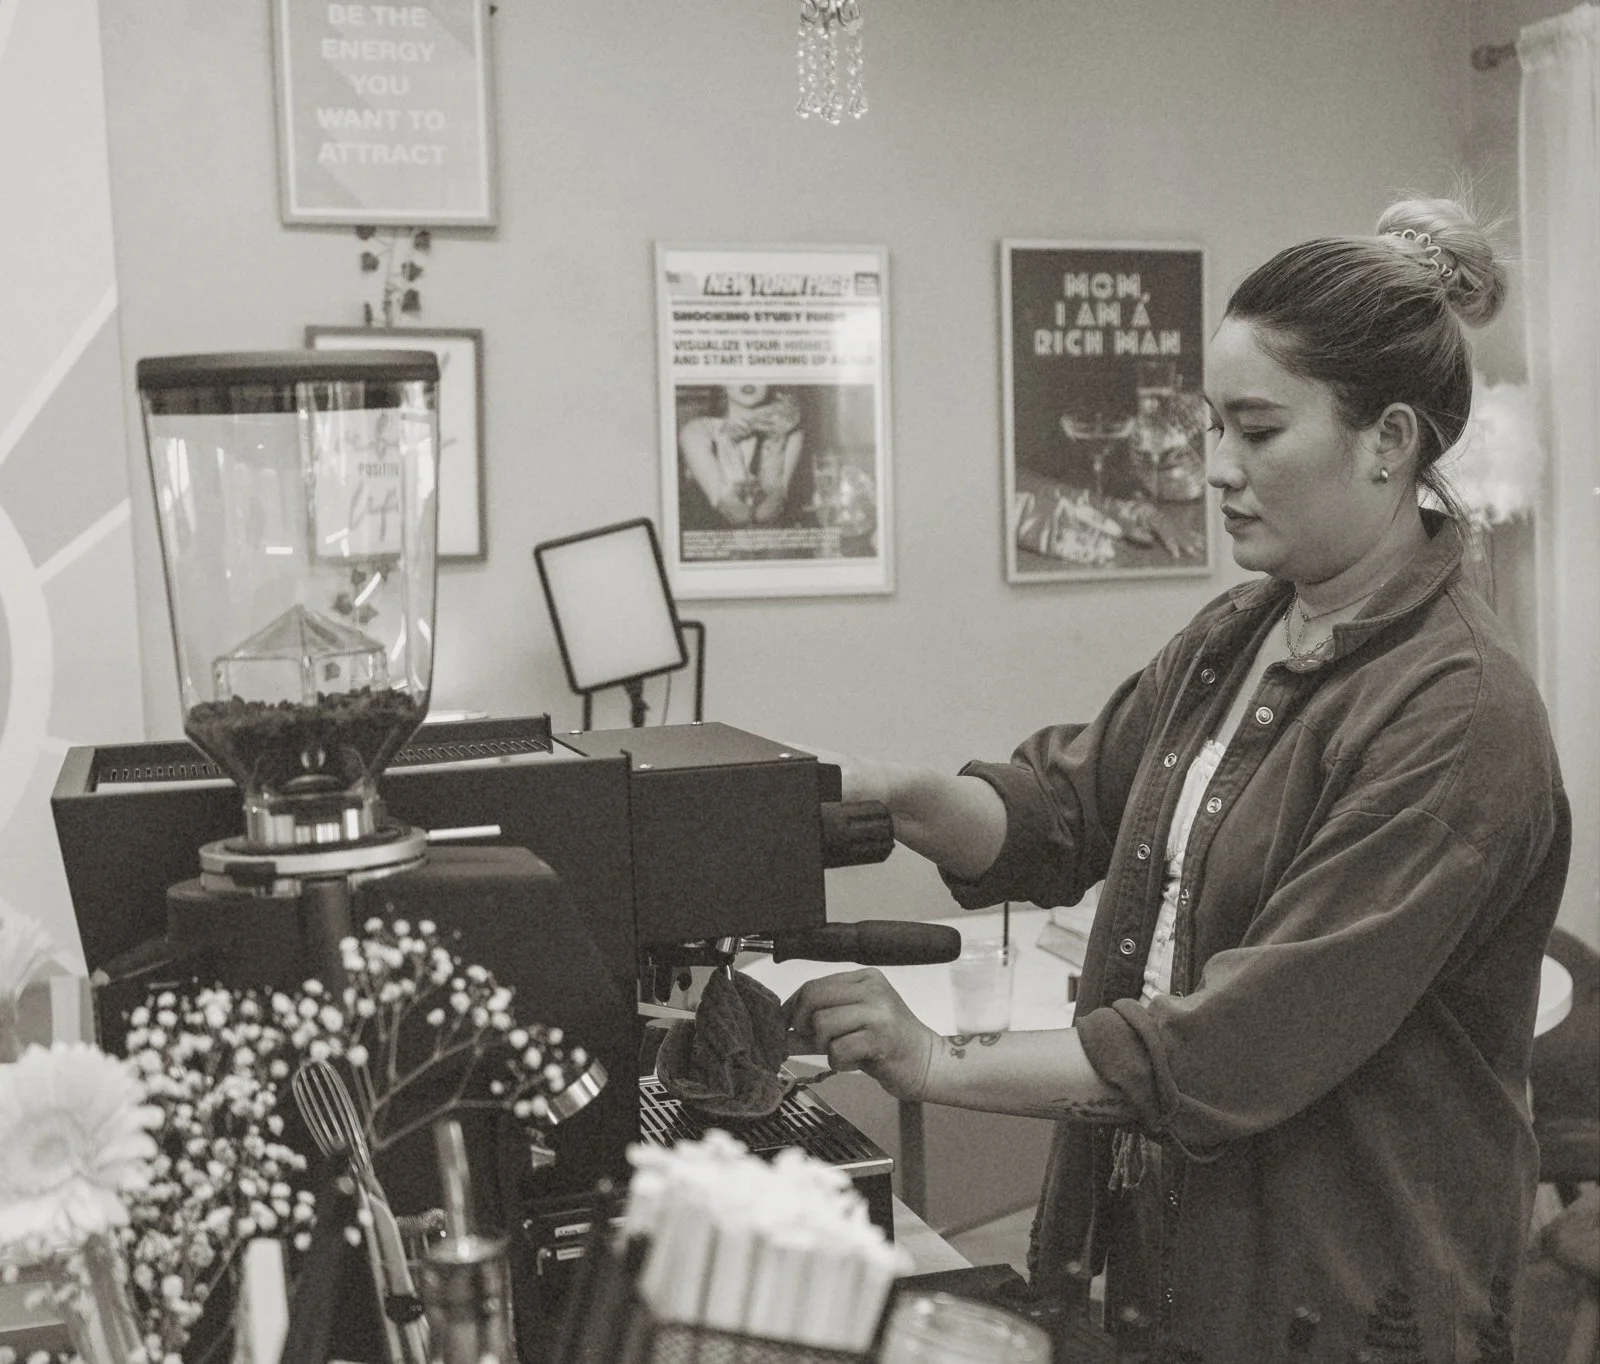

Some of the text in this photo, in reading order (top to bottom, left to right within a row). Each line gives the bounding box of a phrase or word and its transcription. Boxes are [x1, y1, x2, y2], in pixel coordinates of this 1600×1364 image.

[328, 4, 428, 27] BE THE
[321, 38, 434, 62] ENERGY
[352, 74, 410, 96] YOU
[317, 107, 446, 131] WANT TO
[317, 142, 447, 166] ATTRACT
[703, 272, 747, 297] NEW
[1064, 271, 1150, 303] MOM,
[754, 311, 802, 323] STUDY
[1055, 301, 1151, 328] I AM A
[673, 340, 740, 351] VISUALIZE
[745, 340, 779, 351] YOUR
[1034, 329, 1181, 355] RICH MAN
[673, 354, 699, 366] AND
[703, 354, 744, 366] START
[749, 354, 809, 366] SHOWING
[811, 354, 826, 366] UP
